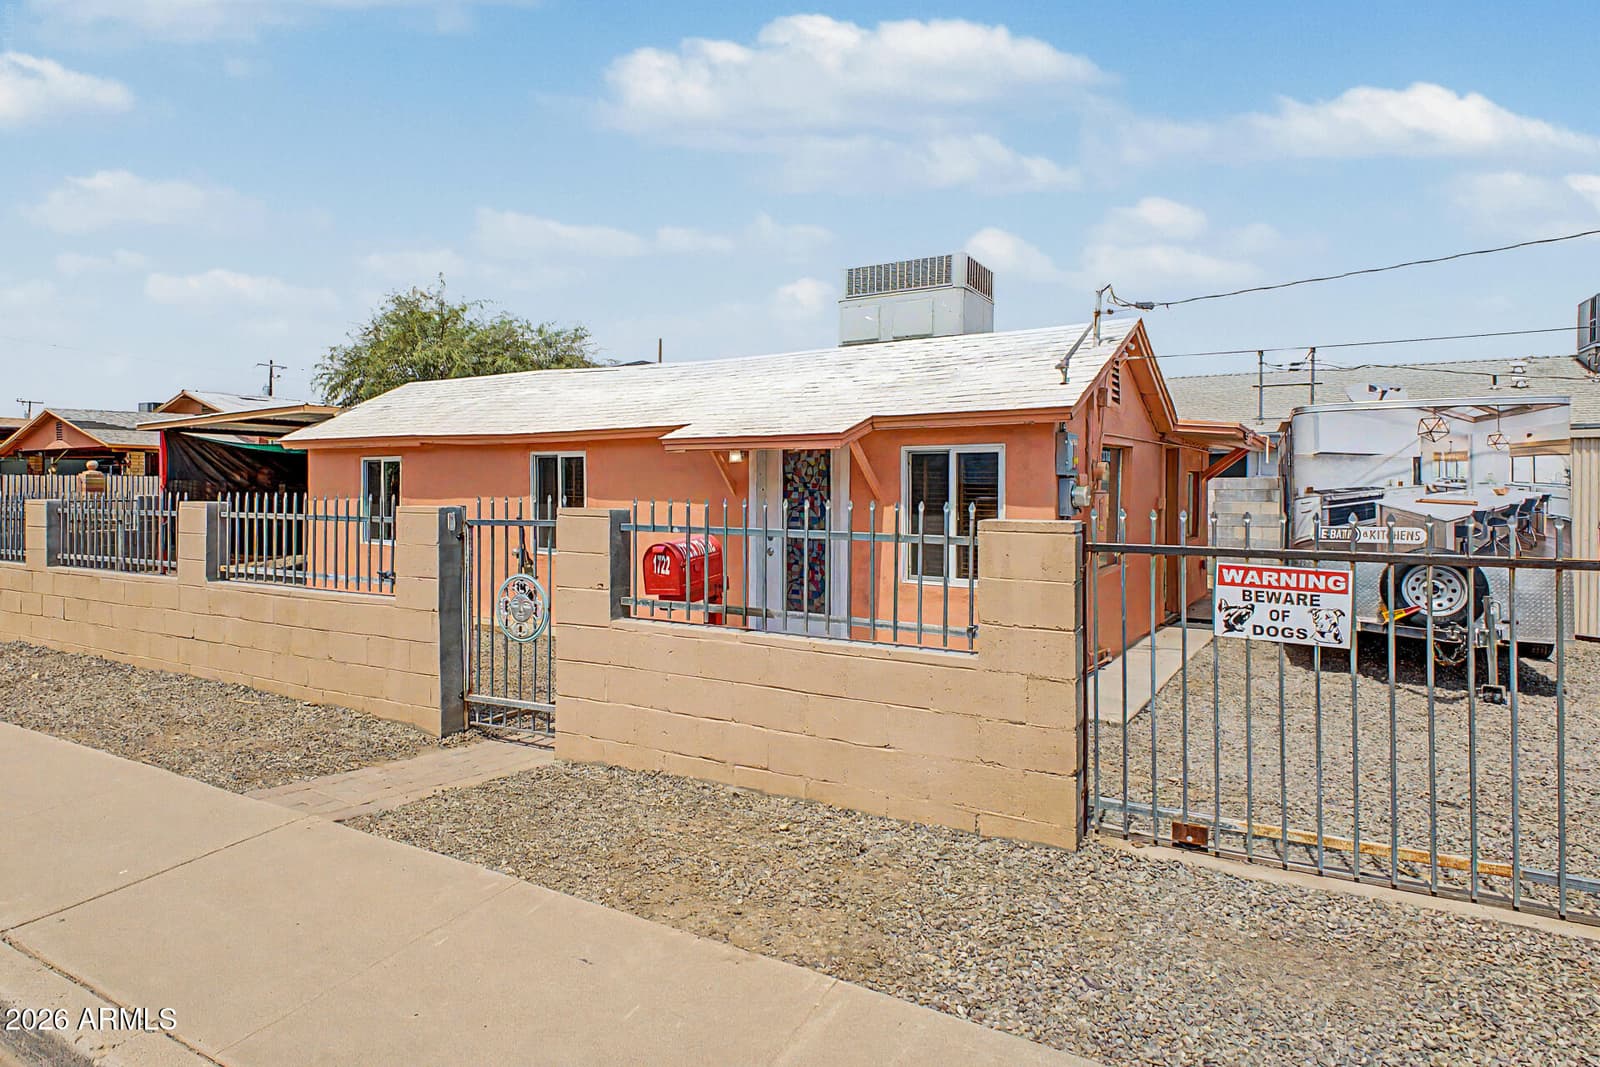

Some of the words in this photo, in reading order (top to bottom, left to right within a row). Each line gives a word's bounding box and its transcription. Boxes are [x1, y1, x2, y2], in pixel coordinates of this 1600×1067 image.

[1370, 529, 1421, 541] KITHENS
[653, 554, 670, 575] 1722
[1222, 568, 1346, 591] WARNING
[1242, 589, 1321, 607] BEWARE
[1268, 609, 1290, 622] OF
[1252, 624, 1308, 639] DOGS
